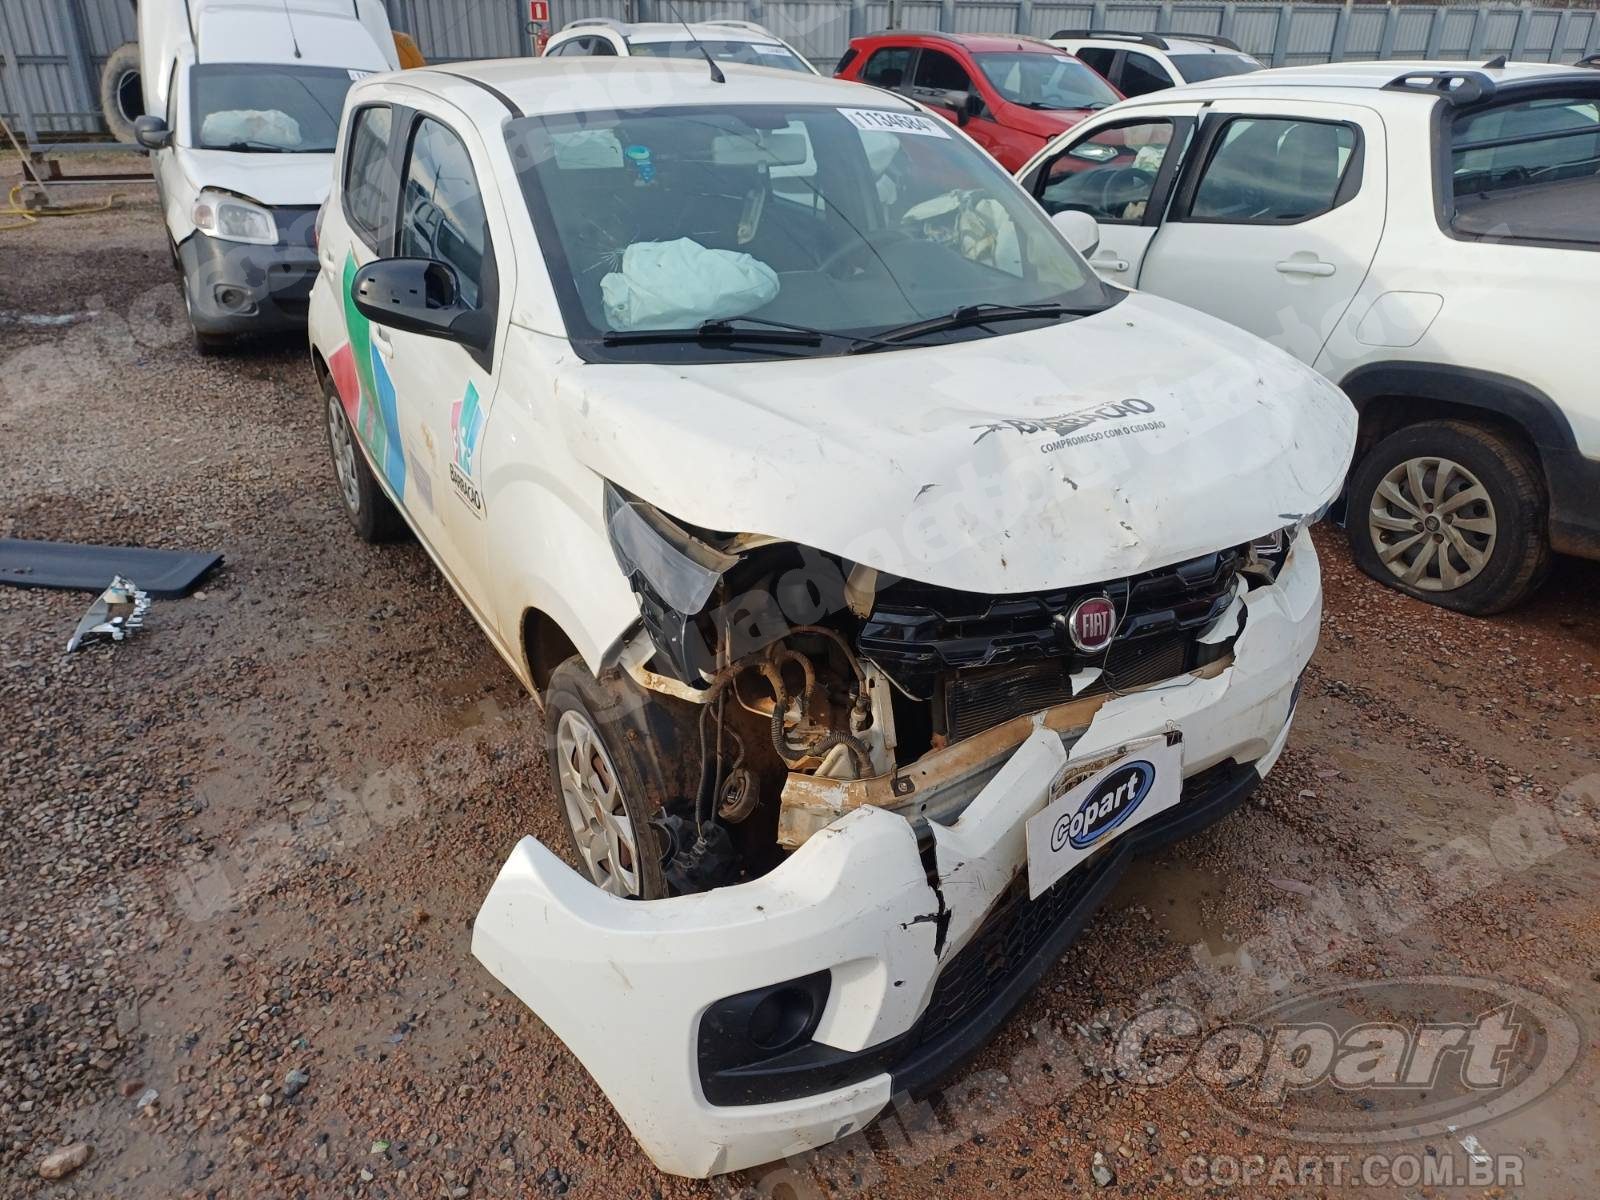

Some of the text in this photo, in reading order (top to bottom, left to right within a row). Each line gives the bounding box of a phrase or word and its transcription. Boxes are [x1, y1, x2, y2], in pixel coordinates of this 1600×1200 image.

[855, 111, 931, 132] 1134684
[1040, 432, 1104, 454] COMPROMISSO
[1104, 428, 1123, 439] COM
[1131, 420, 1166, 433] CIDADÃO
[1083, 611, 1108, 638] FIAT
[1051, 771, 1140, 852] Copart
